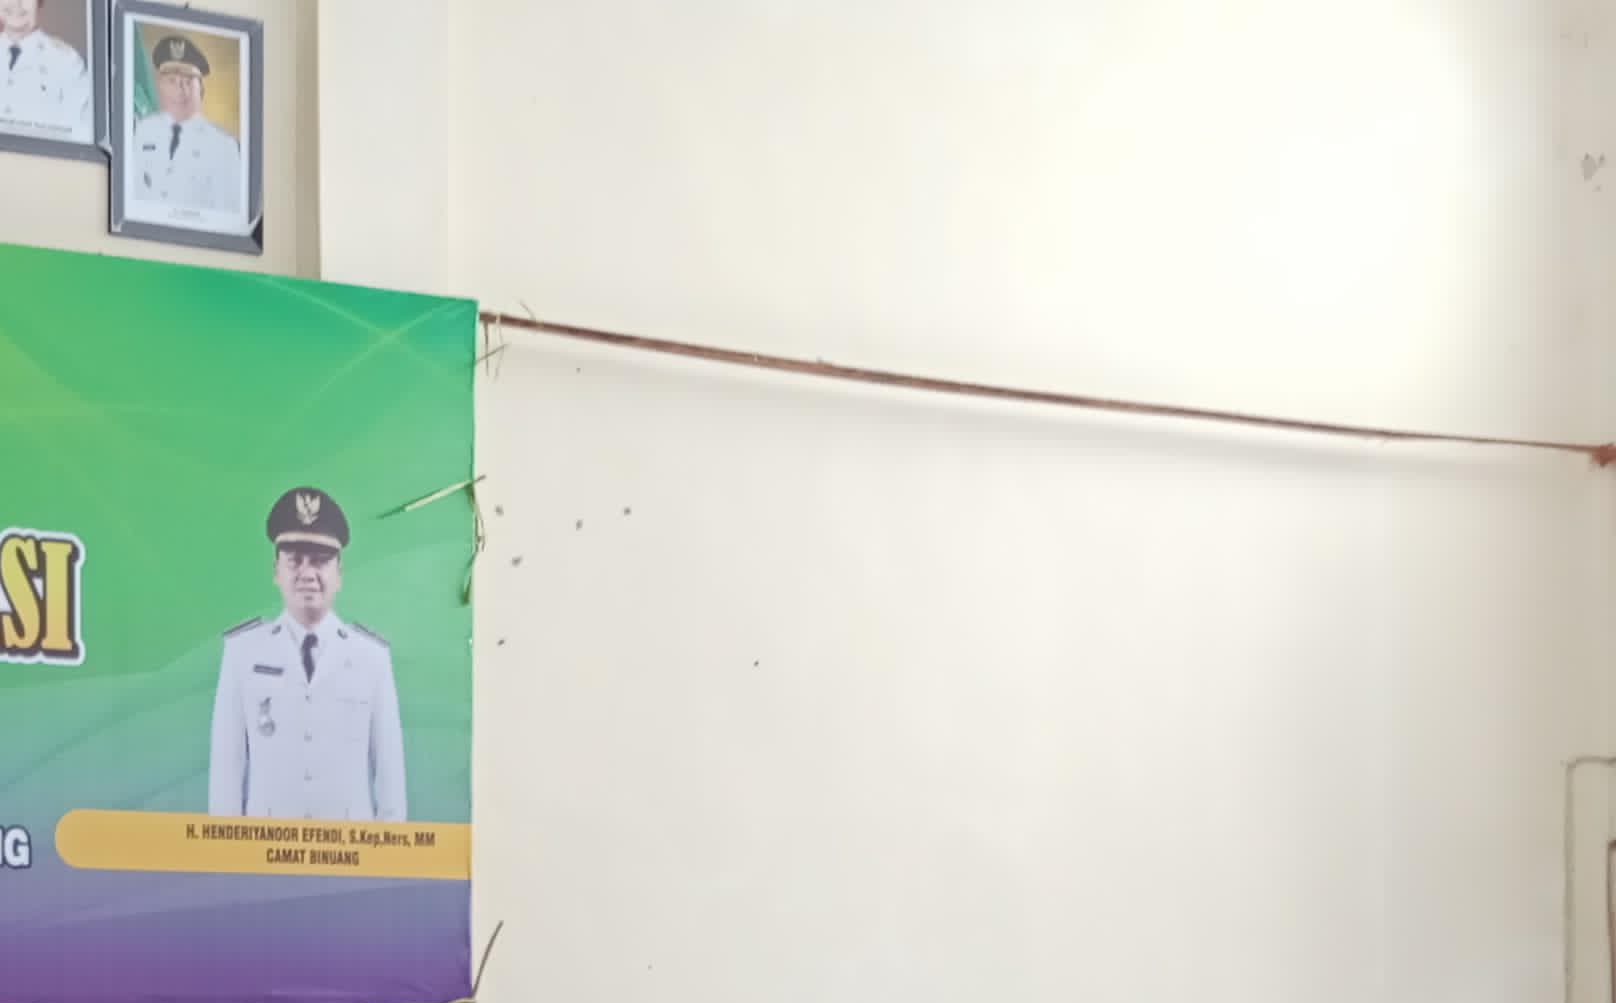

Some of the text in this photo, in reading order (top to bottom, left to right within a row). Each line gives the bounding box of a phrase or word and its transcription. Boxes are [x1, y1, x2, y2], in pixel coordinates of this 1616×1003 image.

[186, 824, 200, 839] H.
[202, 824, 299, 842] HENDERIYANOOR
[302, 827, 345, 845] EFENDI,
[414, 831, 436, 847] MM
[266, 848, 359, 866] CAMAT BINUANG
